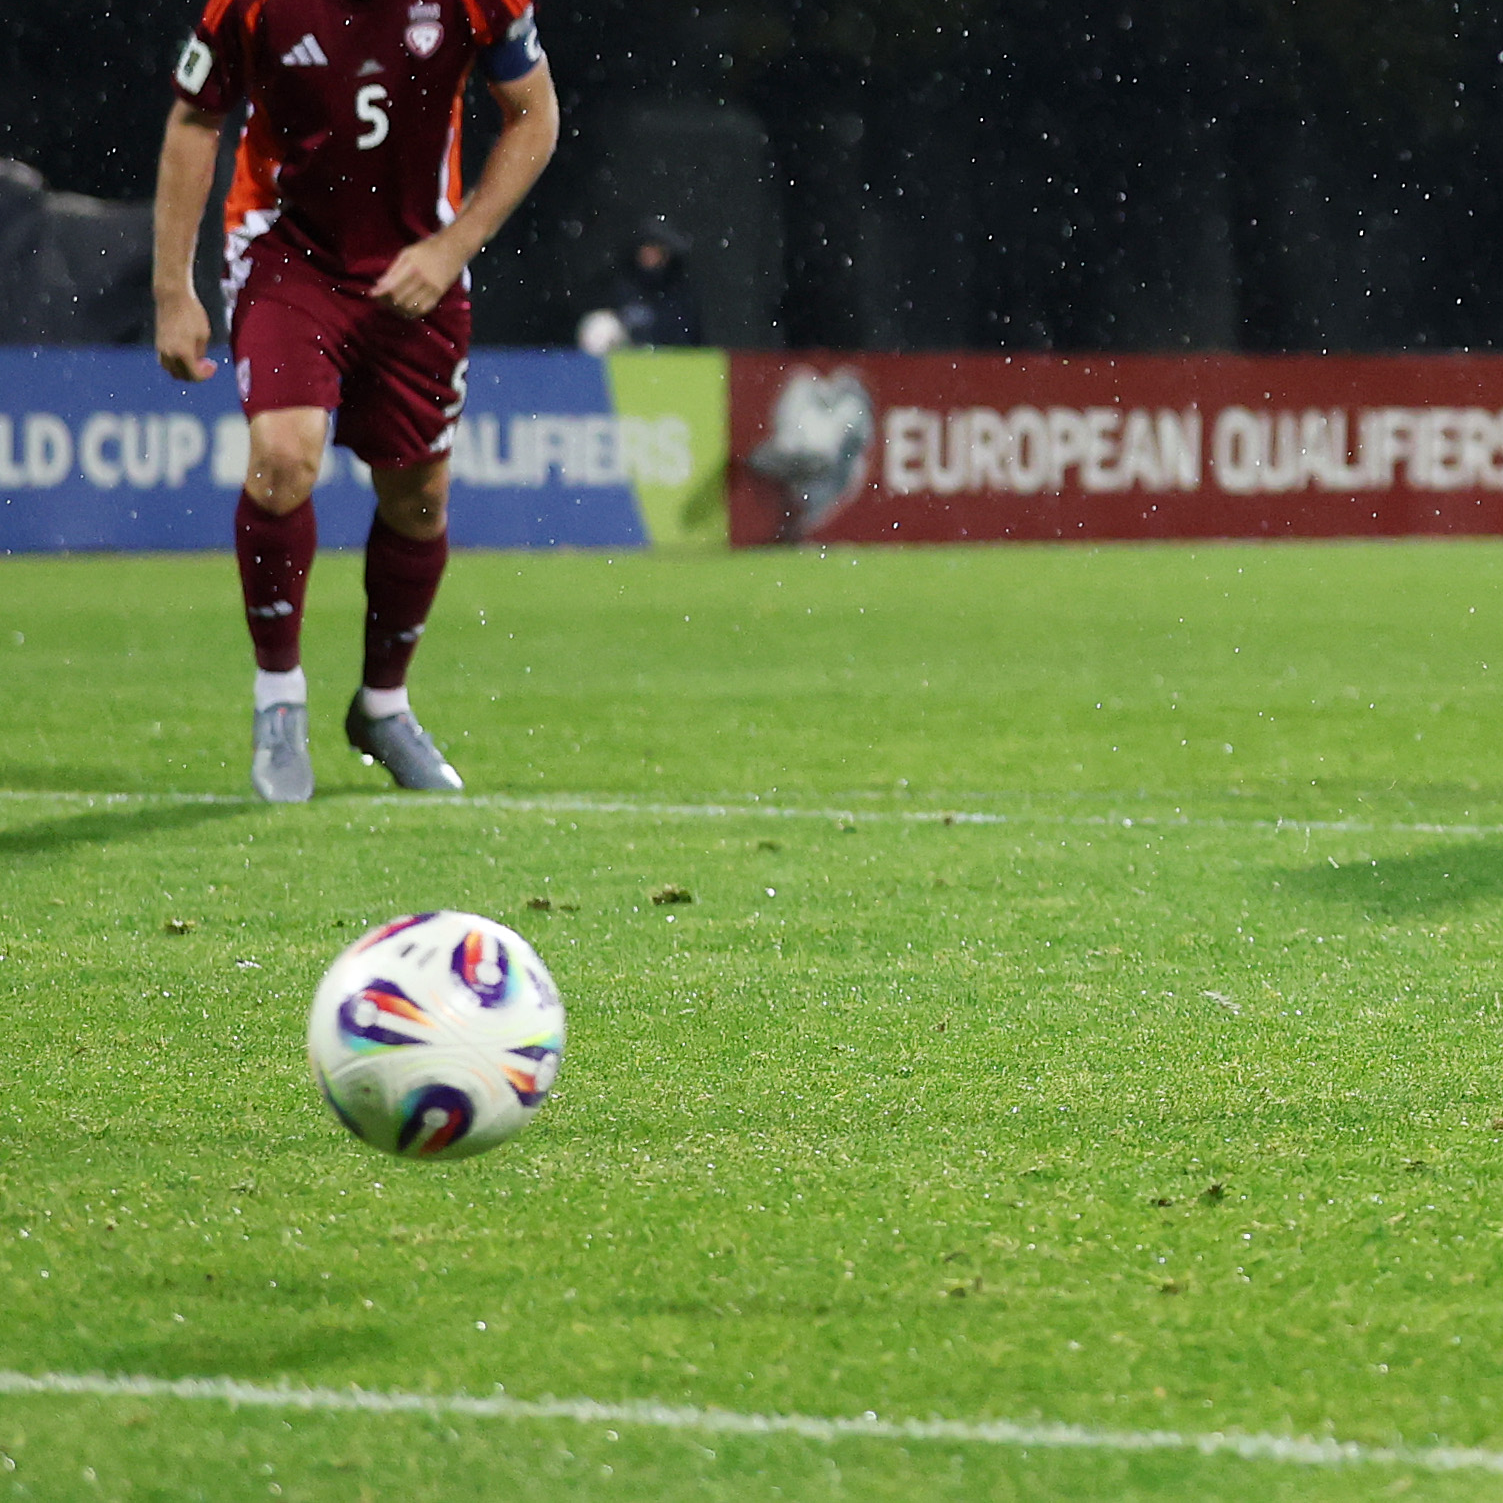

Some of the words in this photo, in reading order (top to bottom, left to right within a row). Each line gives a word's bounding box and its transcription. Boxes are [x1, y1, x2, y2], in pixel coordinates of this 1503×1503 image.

[356, 84, 390, 150] 5
[79, 410, 207, 490] CUP
[884, 407, 1201, 495] EUROPEAN
